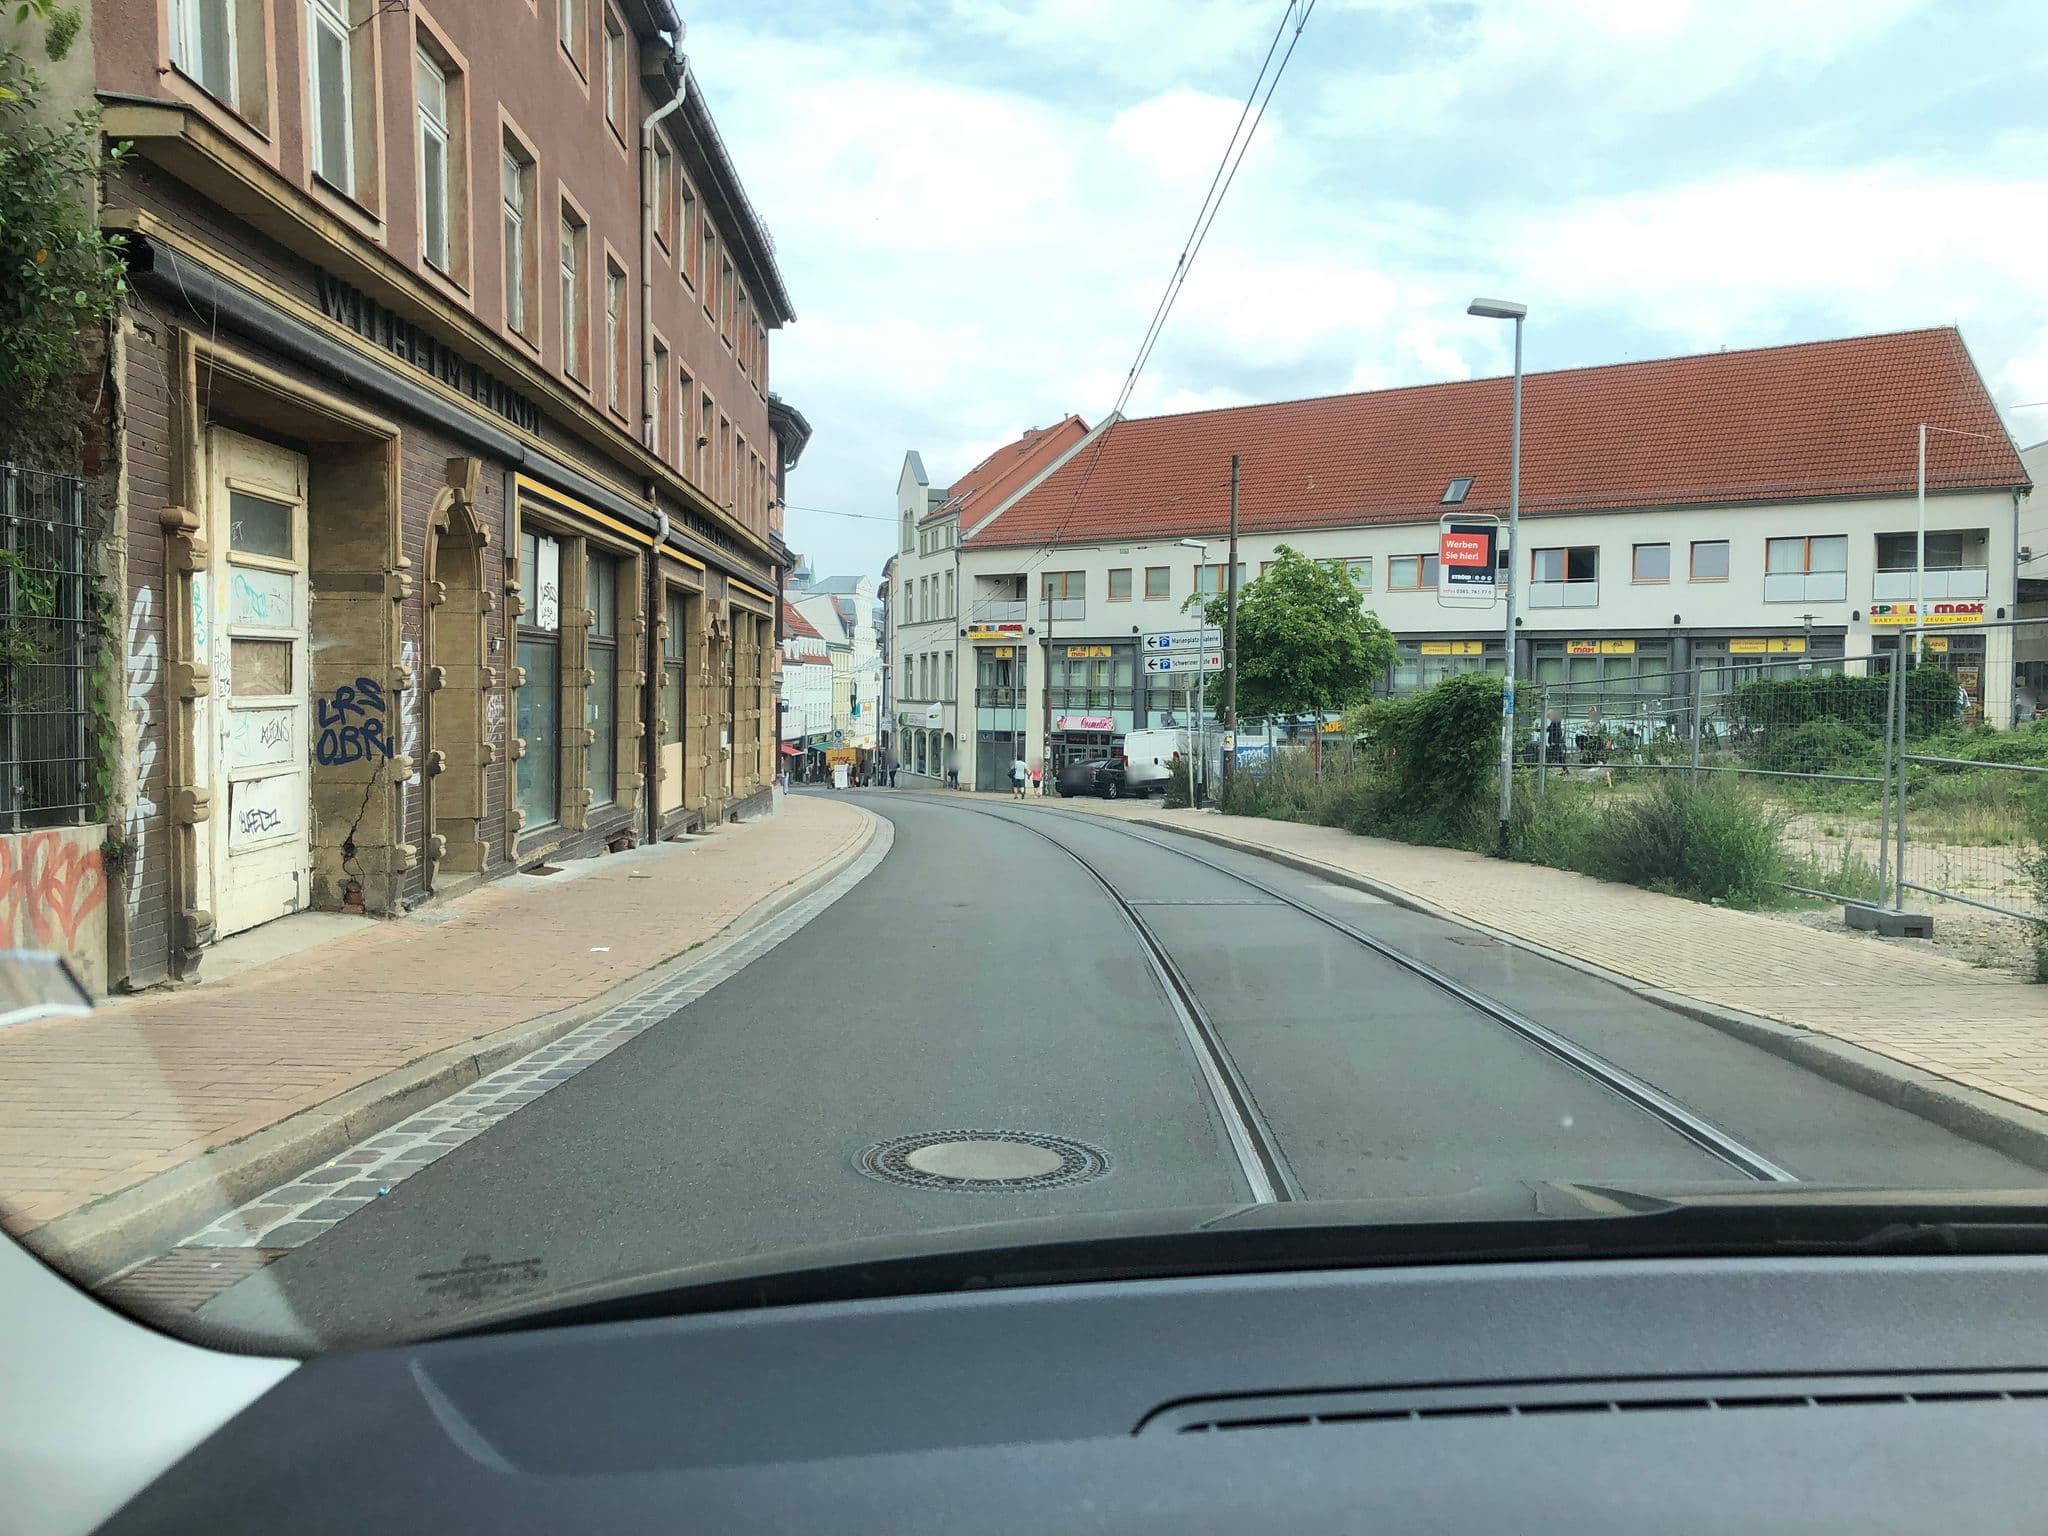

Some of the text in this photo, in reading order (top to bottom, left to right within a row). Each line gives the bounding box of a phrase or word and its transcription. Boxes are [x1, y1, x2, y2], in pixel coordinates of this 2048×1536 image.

[1446, 540, 1479, 549] Werben
[1445, 551, 1479, 560] Sie hier!
